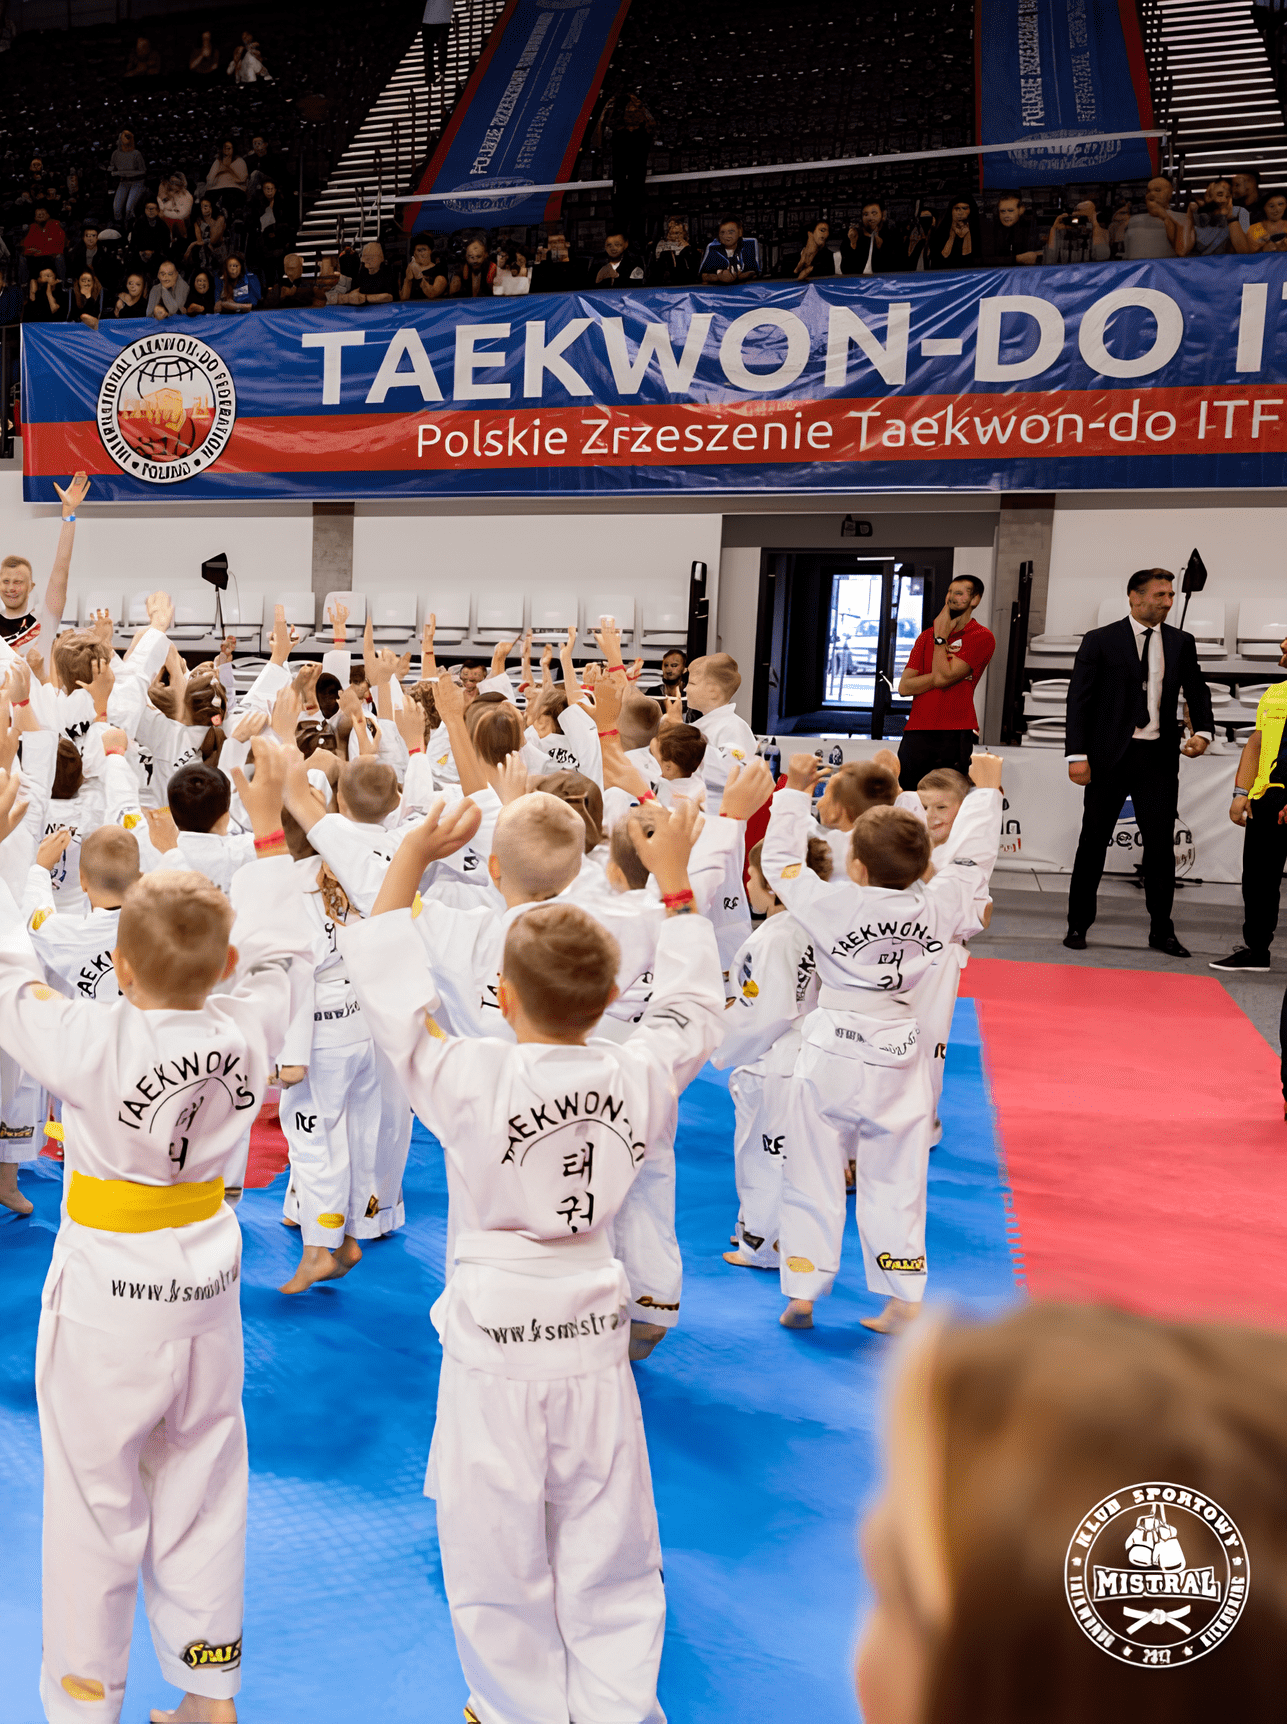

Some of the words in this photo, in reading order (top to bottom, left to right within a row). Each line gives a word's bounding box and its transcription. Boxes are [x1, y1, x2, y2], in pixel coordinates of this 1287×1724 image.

[301, 286, 1185, 405] TAEKWON-DO
[1235, 281, 1287, 373] I
[417, 417, 568, 459] Polskie
[580, 410, 834, 456] Zrzeszenie
[849, 398, 1178, 452] Taekwon-do
[1197, 398, 1284, 440] ITF
